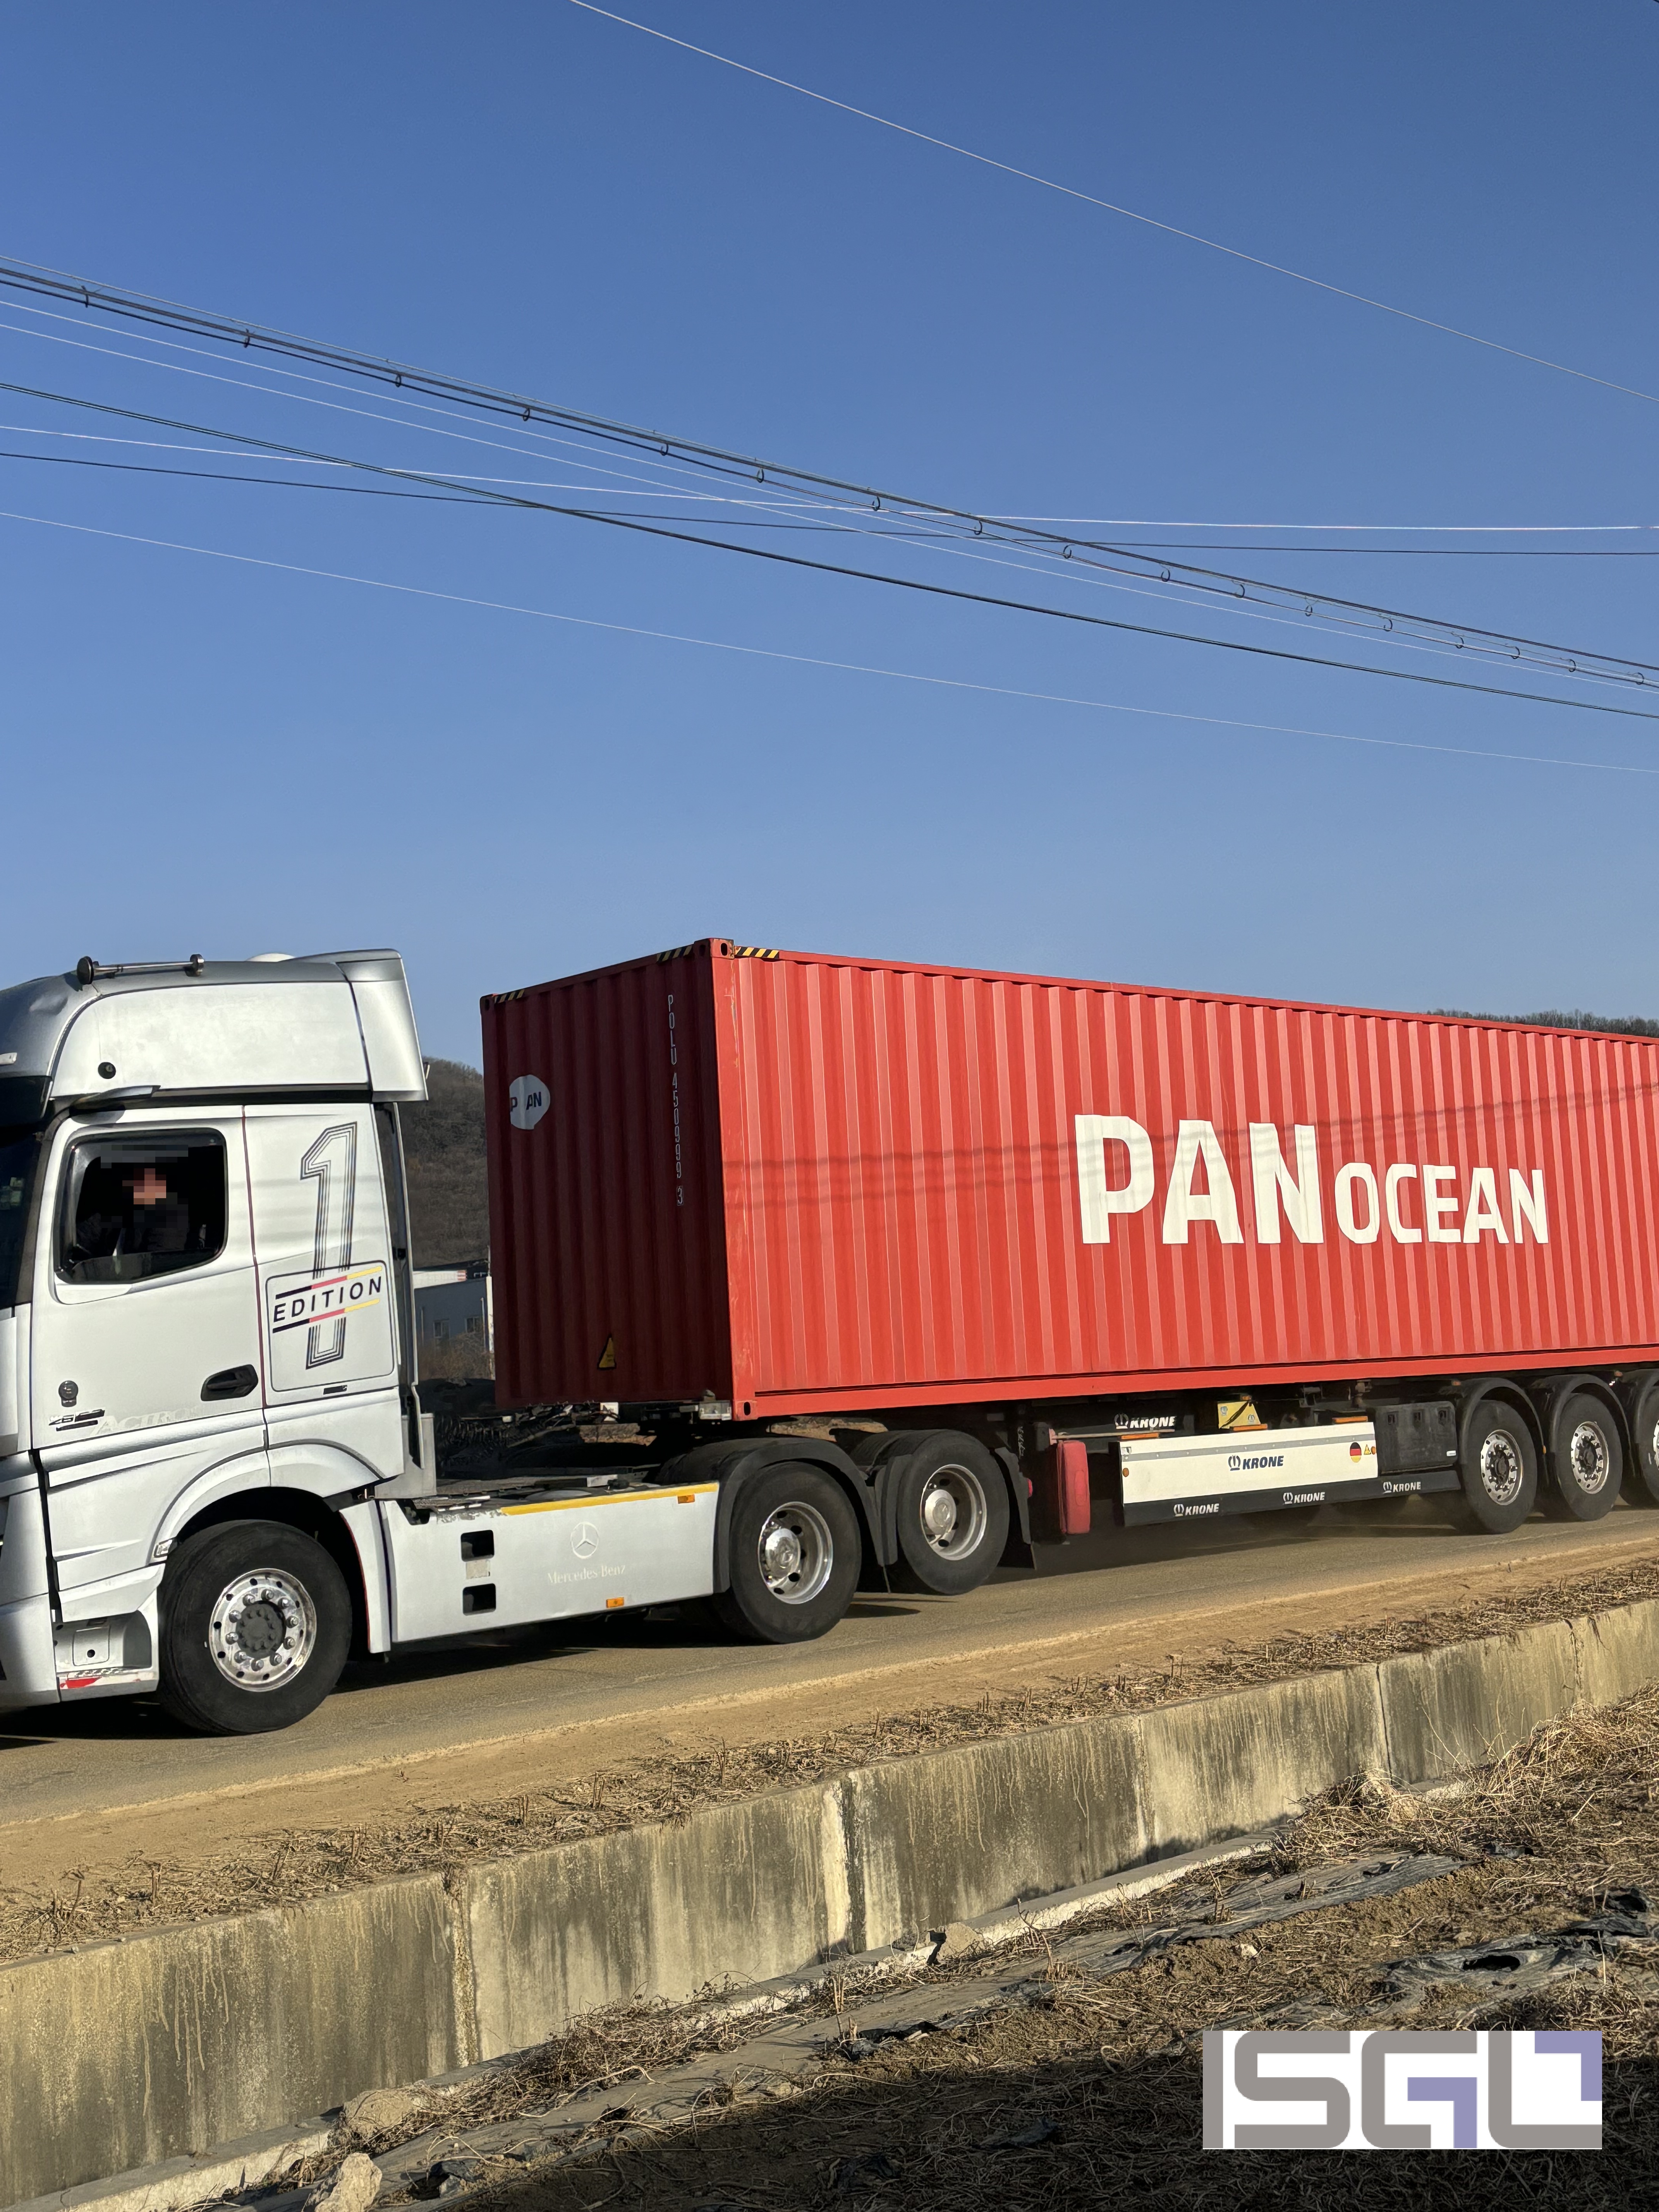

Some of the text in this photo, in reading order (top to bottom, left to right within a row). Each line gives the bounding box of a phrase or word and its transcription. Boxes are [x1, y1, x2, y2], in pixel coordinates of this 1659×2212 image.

[510, 1091, 542, 1112] PAN
[668, 994, 683, 1205] POLU 450999 3
[1074, 1114, 1549, 1244] PAN OCEAN
[273, 1276, 382, 1323] EDITION
[1130, 1416, 1176, 1429] KRONE
[1242, 1455, 1284, 1470] KRONE
[1393, 1481, 1421, 1492] KRONE
[1293, 1492, 1325, 1503] KRONE
[1185, 1503, 1219, 1516] KRONE
